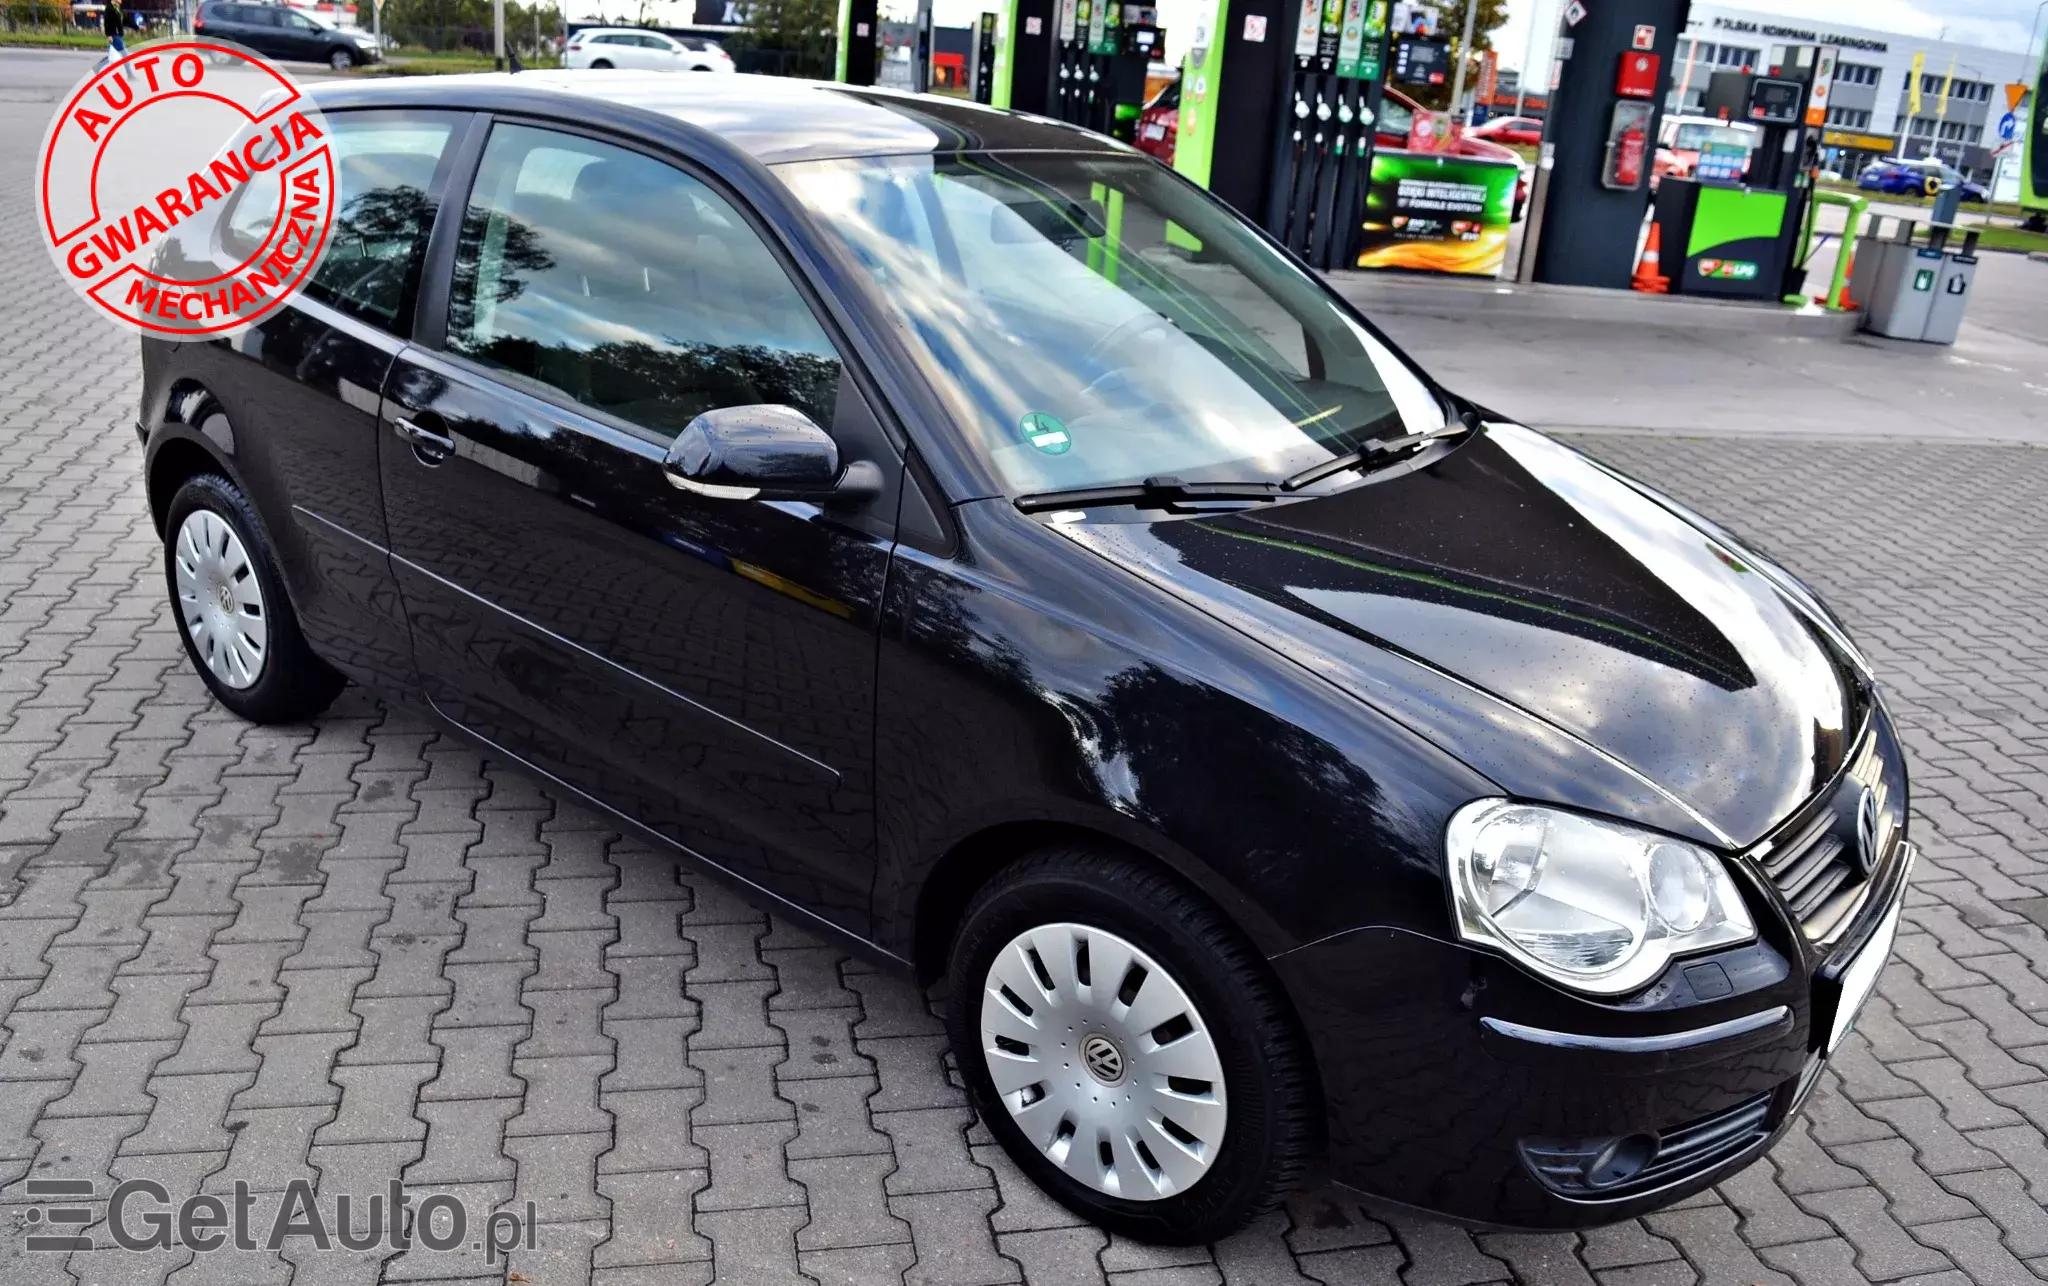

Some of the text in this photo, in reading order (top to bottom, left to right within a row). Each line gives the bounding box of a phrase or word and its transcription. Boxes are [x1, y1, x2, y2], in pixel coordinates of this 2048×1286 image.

[1714, 16, 1888, 53] POLSKA KOMPANIA LEASINGOWA
